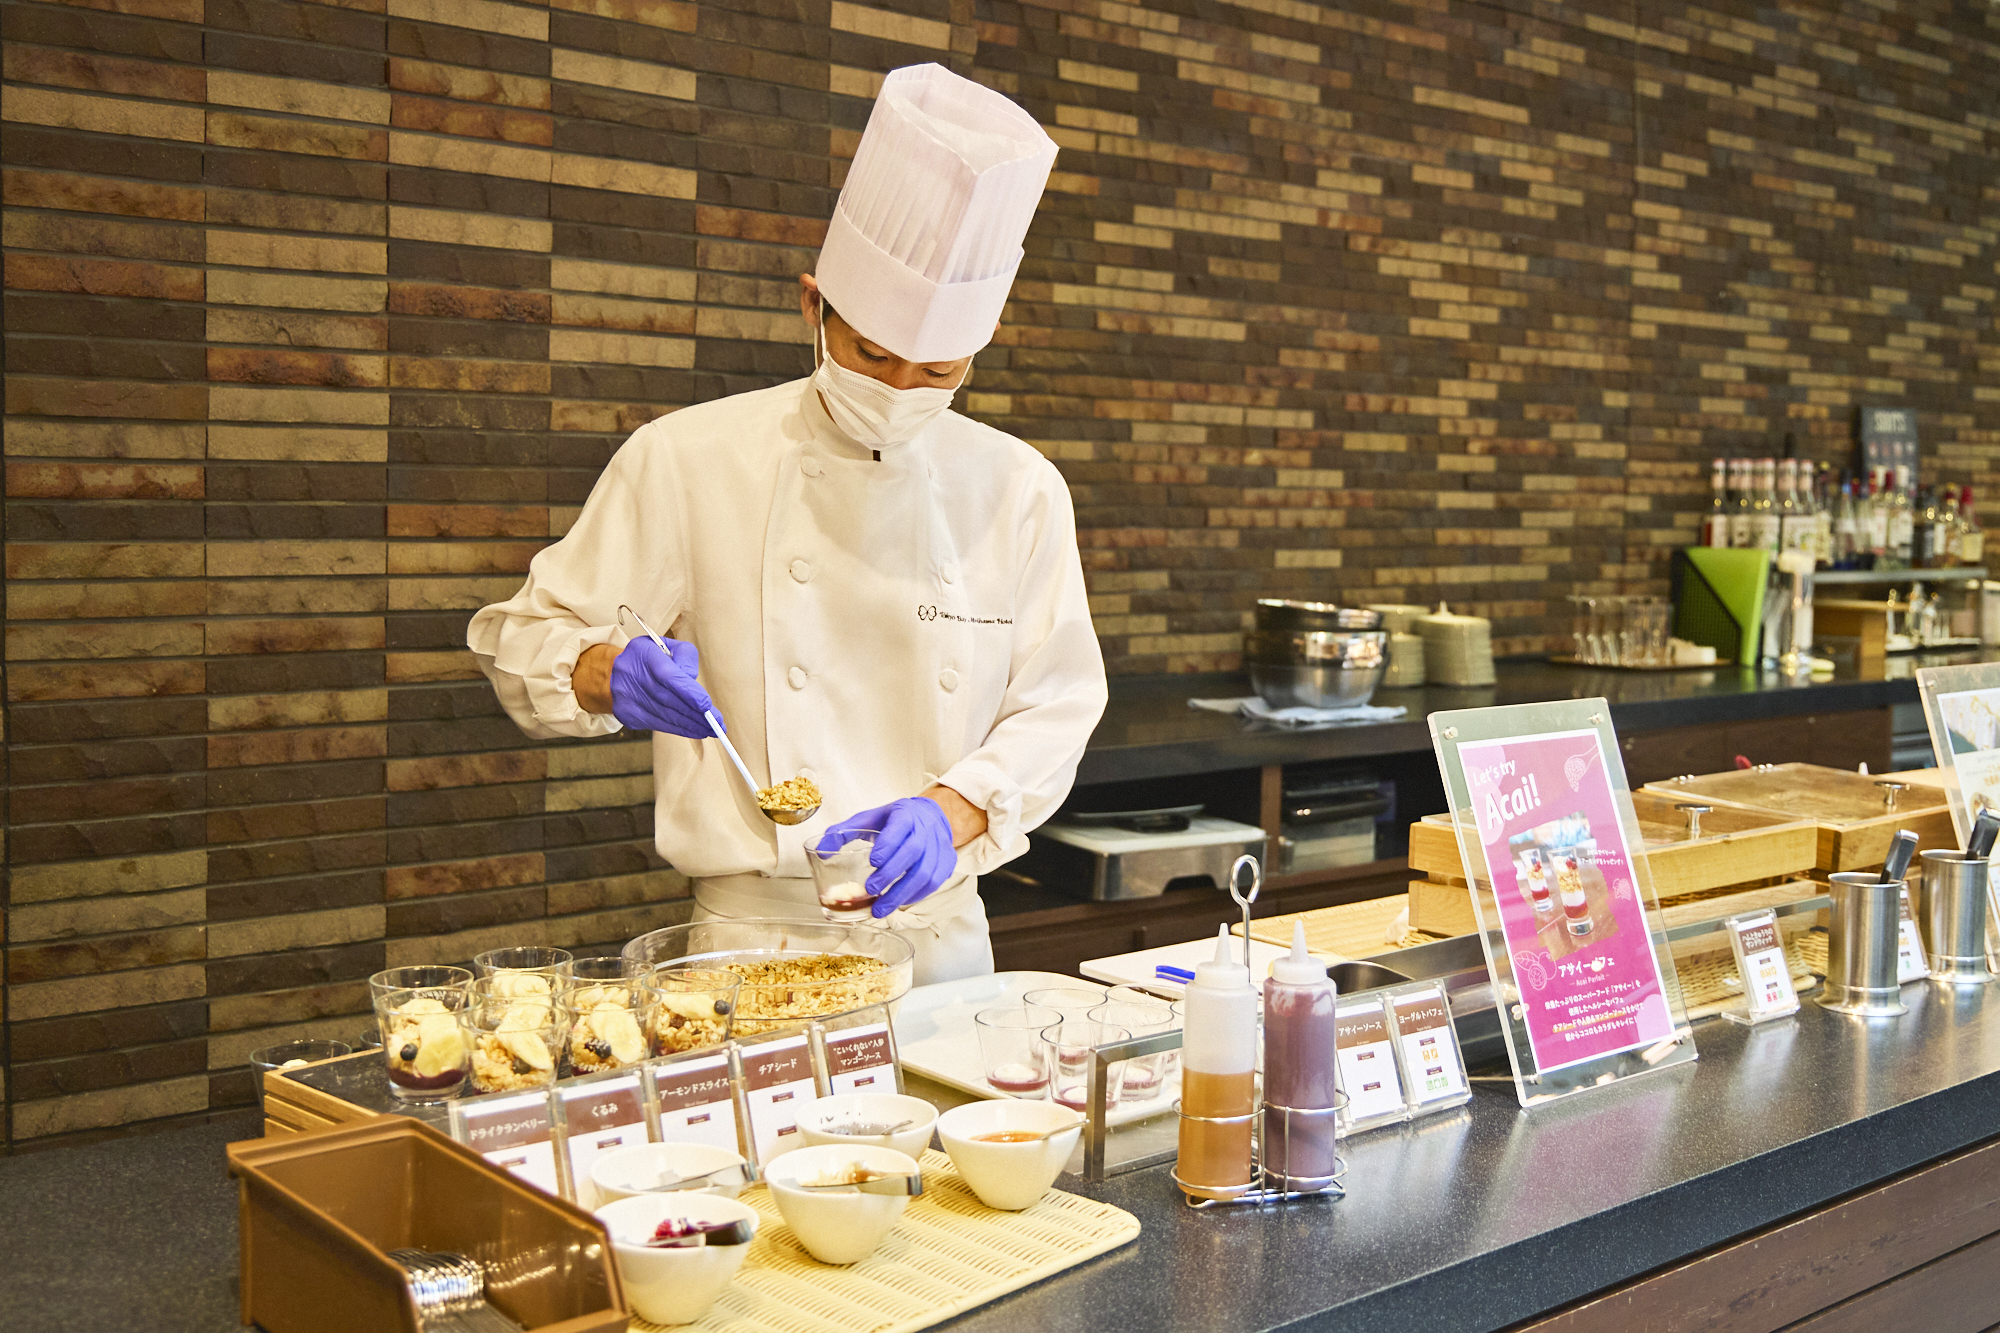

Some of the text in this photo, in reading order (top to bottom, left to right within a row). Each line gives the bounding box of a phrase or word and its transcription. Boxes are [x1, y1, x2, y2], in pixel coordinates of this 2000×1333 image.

[1473, 759, 1516, 787] Let's try
[1485, 773, 1541, 831] Acai!
[1558, 956, 1615, 978] アサイーフェ
[1398, 1008, 1444, 1024] ヨーグルトパフェ
[1338, 1021, 1383, 1037] アサイーソース
[759, 1058, 797, 1075] チアシード
[840, 1052, 882, 1066] マンゴーソース
[660, 1078, 729, 1100] アーモンドスライス
[591, 1103, 619, 1117] くるみ
[470, 1118, 547, 1141] ドライクランベリー
